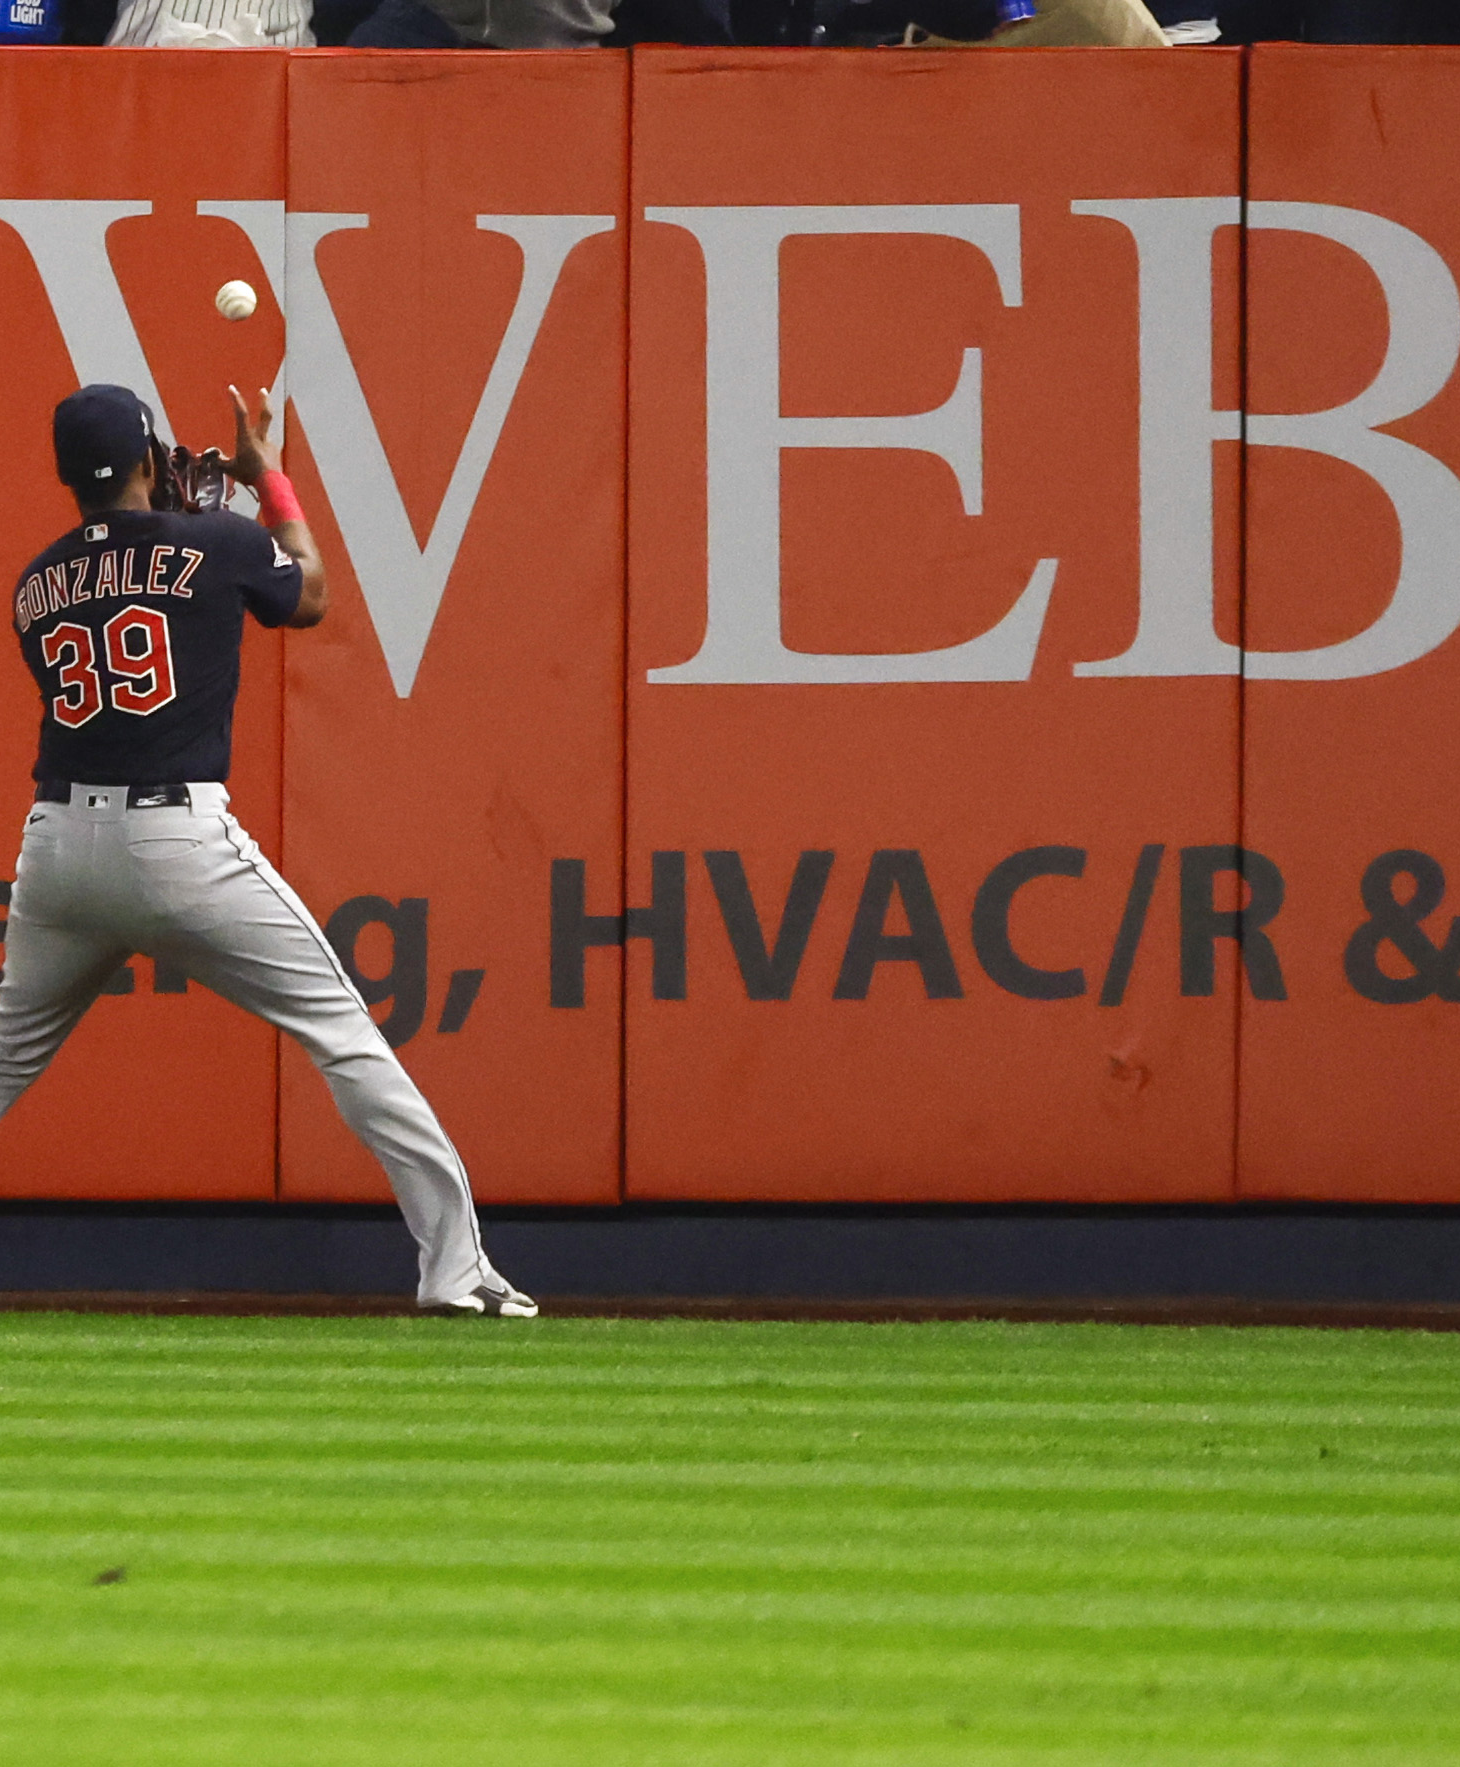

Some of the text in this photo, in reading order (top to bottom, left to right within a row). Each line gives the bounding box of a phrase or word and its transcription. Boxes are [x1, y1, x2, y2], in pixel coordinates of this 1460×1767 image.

[9, 5, 46, 26] LIGHT
[14, 544, 204, 633] GONZALEZ
[40, 603, 177, 729] 39
[547, 841, 1289, 1010] HVAC/R
